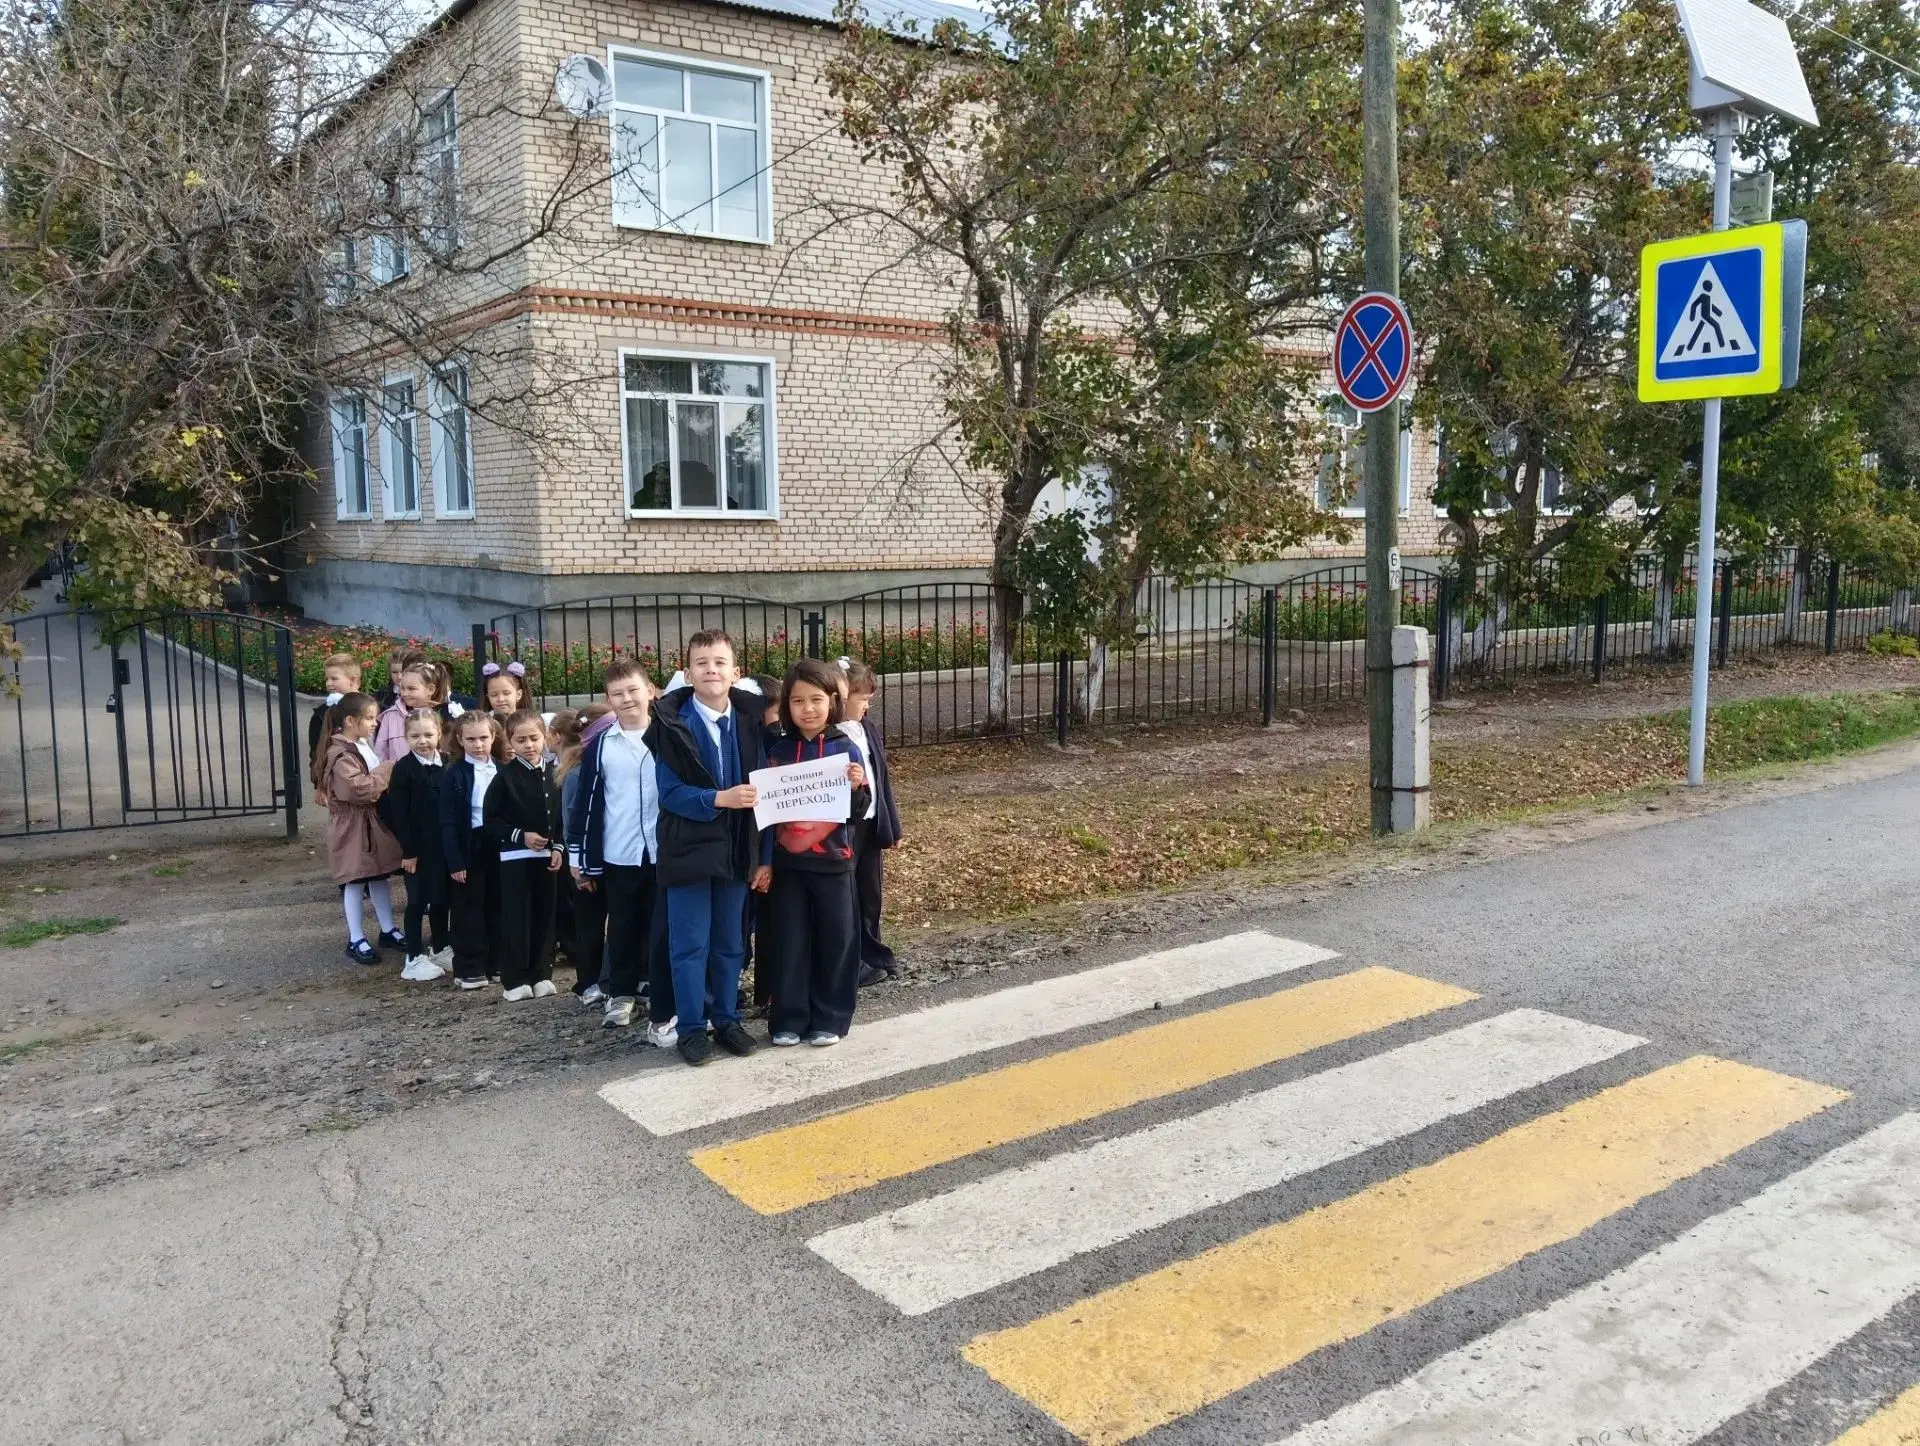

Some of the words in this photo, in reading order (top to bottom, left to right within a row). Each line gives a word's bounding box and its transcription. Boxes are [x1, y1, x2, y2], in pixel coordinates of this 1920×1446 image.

[1391, 553, 1397, 566] 6
[780, 770, 823, 783] Станция
[761, 776, 846, 800] «БЕЗОПАСНЫЙ
[776, 793, 836, 809] ПЕРЕХОД»
